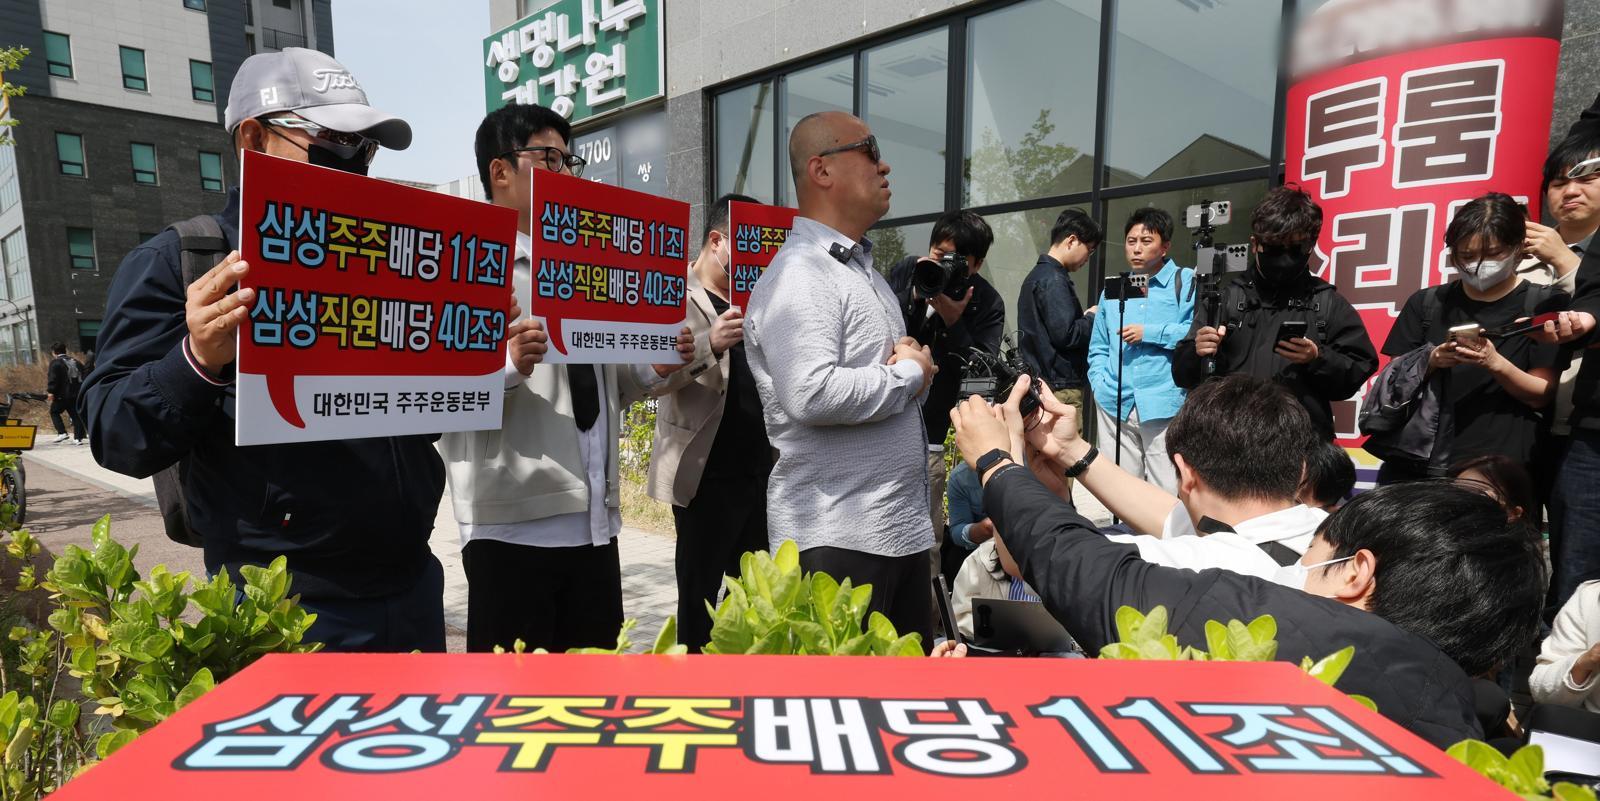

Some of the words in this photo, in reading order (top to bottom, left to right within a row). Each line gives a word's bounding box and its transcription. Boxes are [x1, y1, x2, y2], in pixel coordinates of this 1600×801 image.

[260, 86, 278, 106] FJ
[1301, 58, 1505, 199] 투룸
[258, 202, 444, 282] 삼성주주배당
[449, 232, 510, 288] 11조!
[540, 201, 645, 256] 삼성주주배당
[648, 220, 686, 260] 11조!
[536, 258, 641, 306] 삼성직원배당
[642, 270, 686, 308] 40조?
[734, 264, 767, 293] 삼성
[249, 288, 434, 353] 삼성직원배당
[437, 302, 507, 352] 40조?
[572, 331, 616, 349] 대한민국
[619, 333, 678, 351] 주주운동본부
[313, 393, 389, 417] 대한민국
[396, 391, 491, 414] 주주운동본부
[176, 695, 1022, 776] 삼성주주배당
[1032, 697, 1432, 777] 11조!
